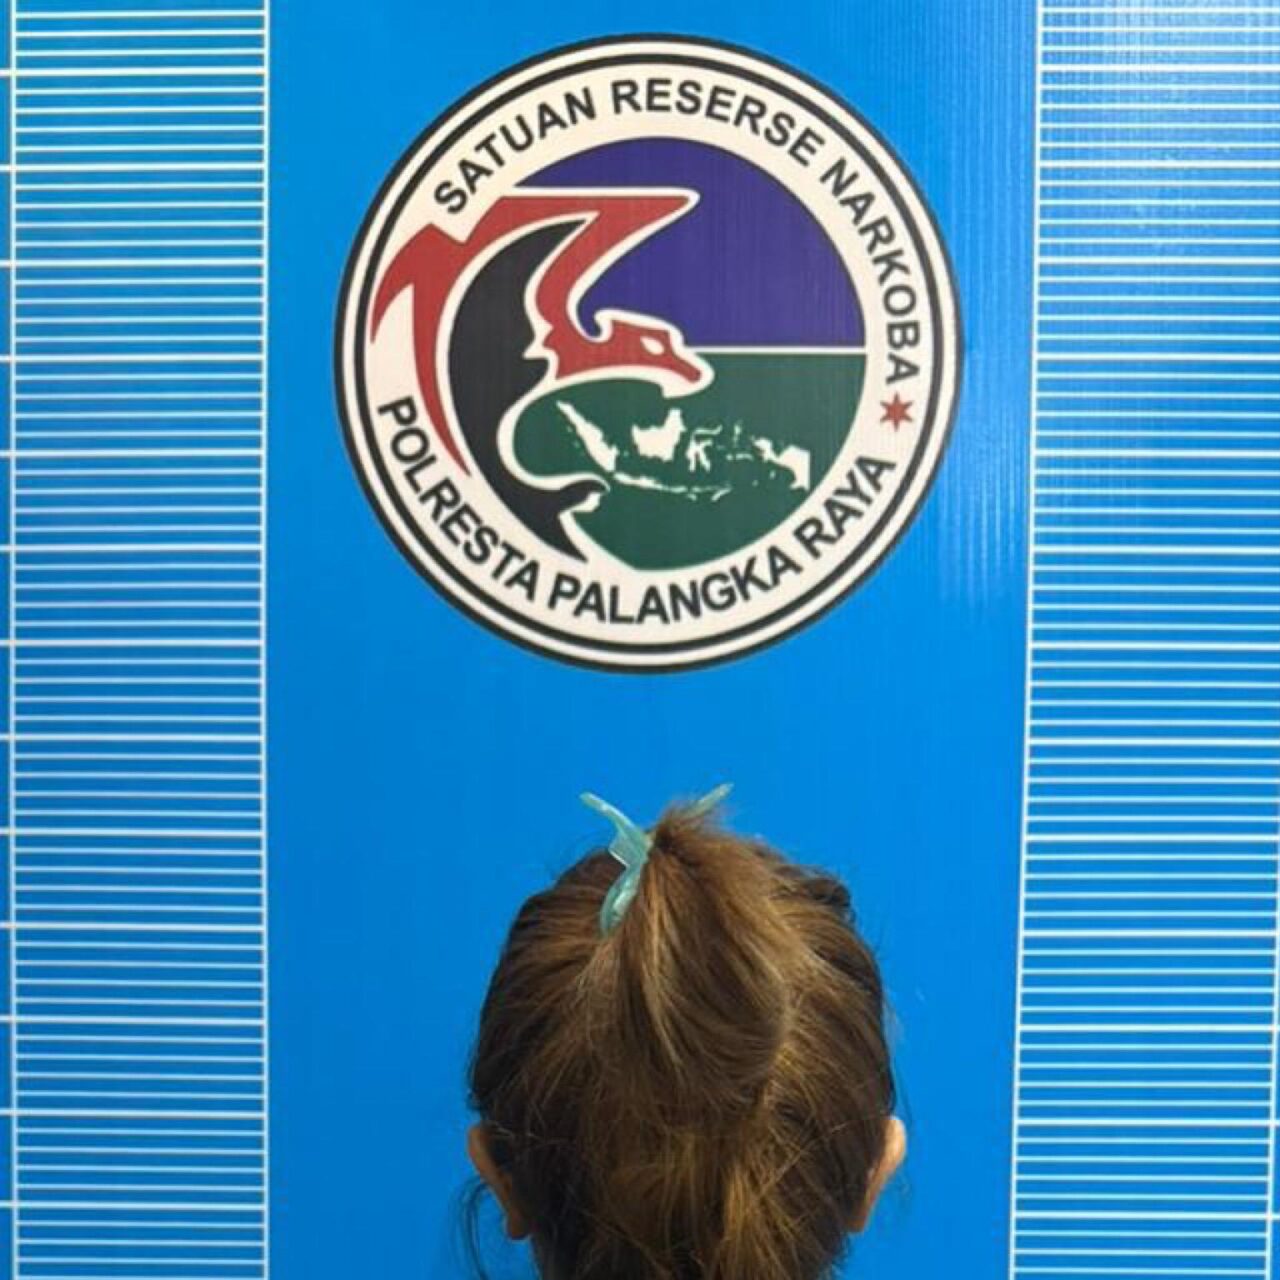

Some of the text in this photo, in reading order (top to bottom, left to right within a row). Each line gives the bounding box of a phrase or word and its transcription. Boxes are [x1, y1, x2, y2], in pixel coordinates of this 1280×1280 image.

[433, 77, 921, 385] SATUAN RESERSE NARKOBA
[376, 395, 897, 625] POLRESTA PALANGKA RAYA
